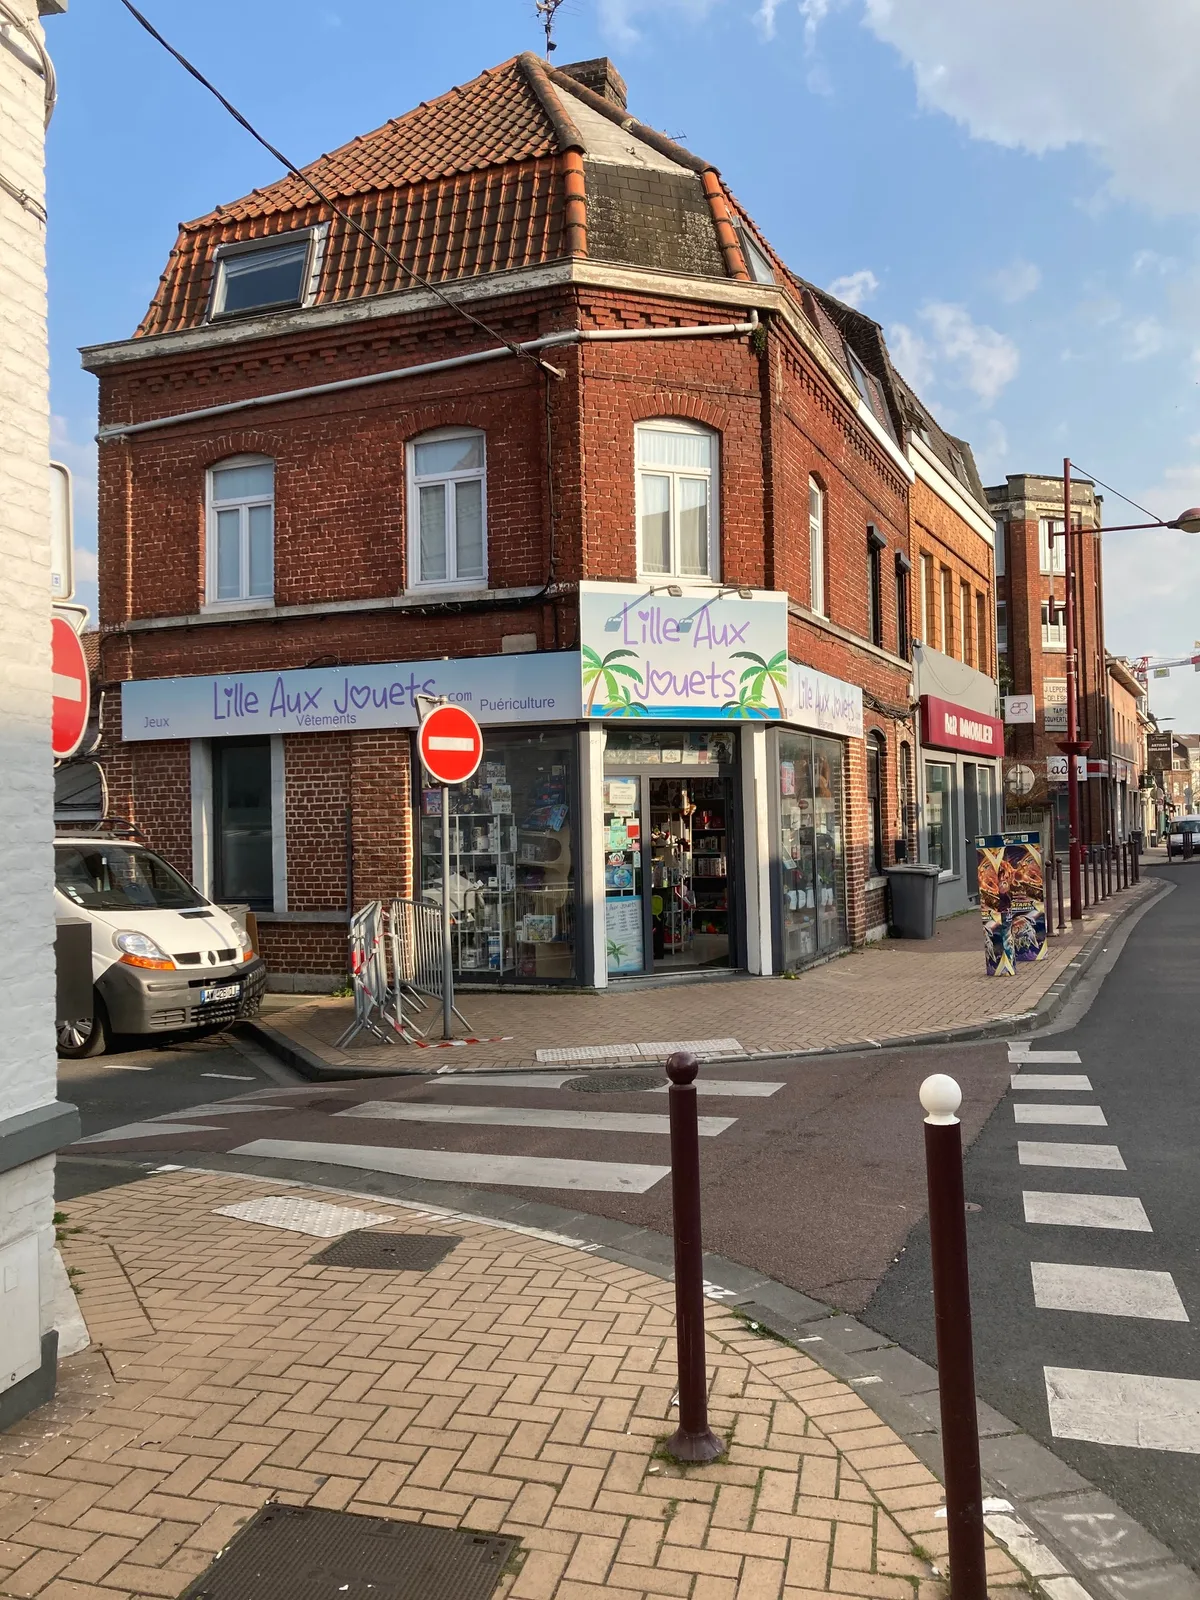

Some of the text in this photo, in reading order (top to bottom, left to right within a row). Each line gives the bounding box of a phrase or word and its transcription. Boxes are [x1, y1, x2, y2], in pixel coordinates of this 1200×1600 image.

[623, 601, 751, 650] Lille Aux
[633, 660, 736, 700] Jouets
[213, 681, 259, 720] Lille
[269, 676, 323, 718] Aux
[333, 672, 436, 714] Jouets
[480, 696, 555, 711] Puériculture
[143, 716, 170, 729] Jeux
[296, 713, 357, 727] Vêtements
[959, 717, 993, 745] IMMOBILIER
